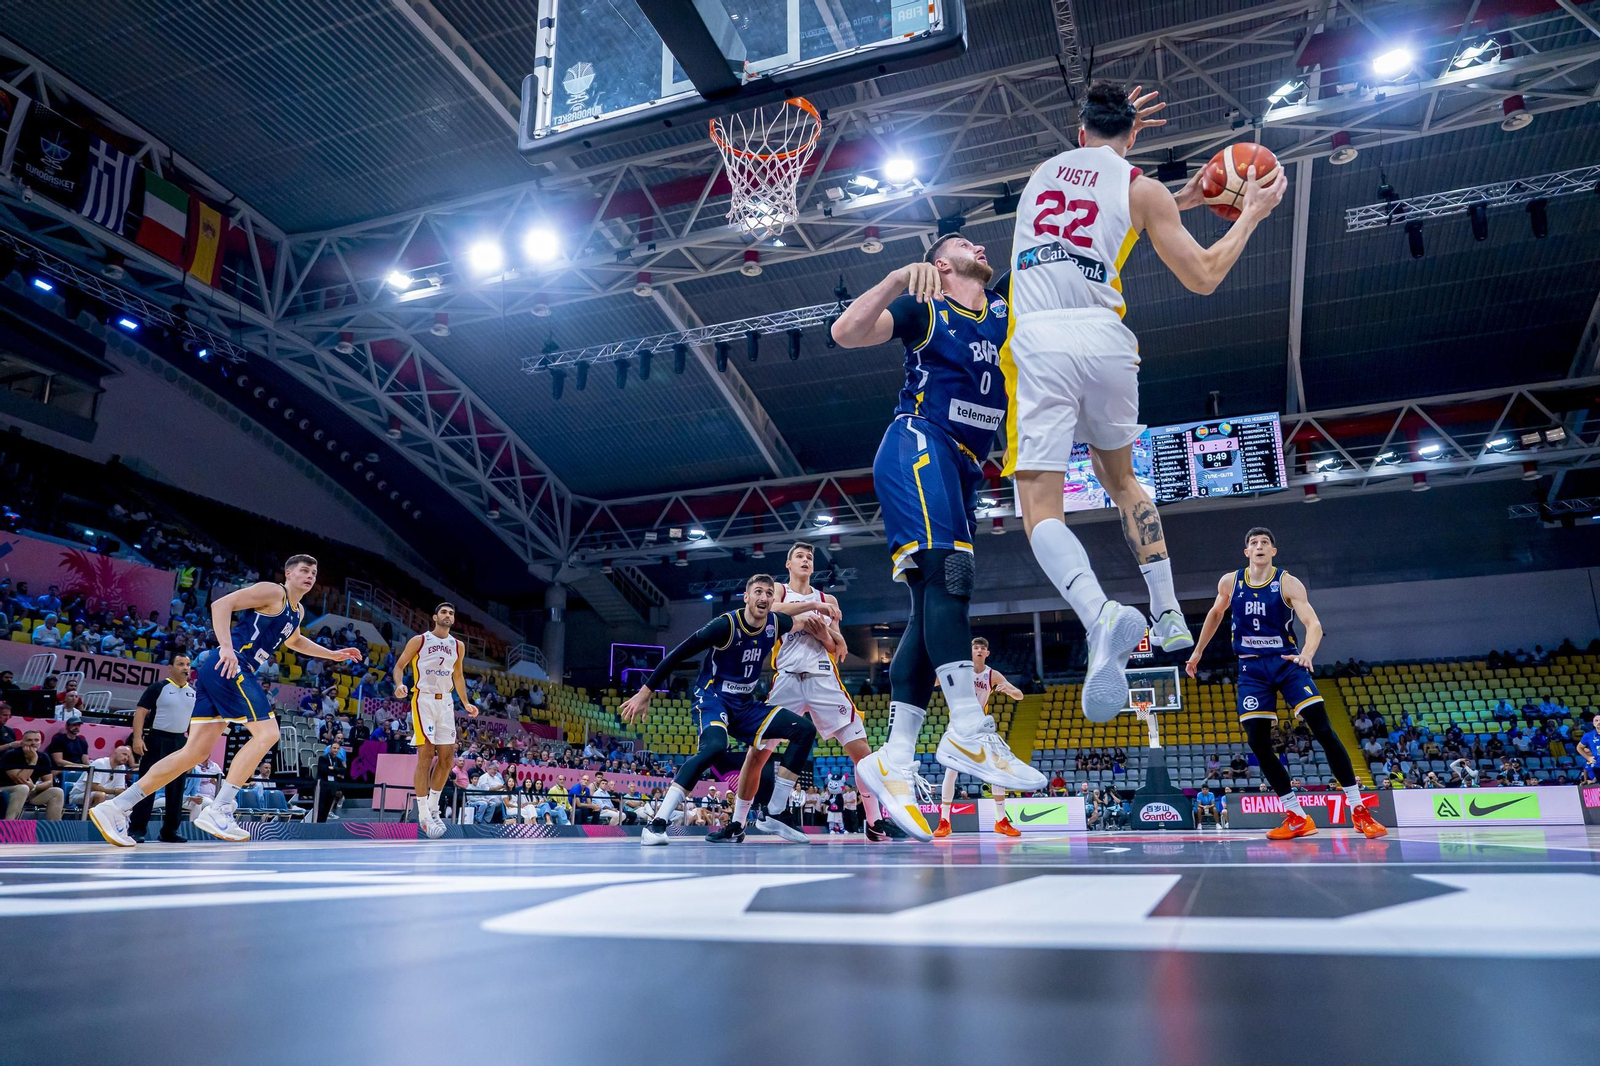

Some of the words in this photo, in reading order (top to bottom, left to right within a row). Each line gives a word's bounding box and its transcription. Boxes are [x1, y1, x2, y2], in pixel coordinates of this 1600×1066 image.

[25, 162, 76, 190] EUROBASKET
[1055, 165, 1100, 187] YUSTA
[1033, 190, 1099, 248] 22
[980, 371, 991, 395] 0
[956, 405, 1001, 425] telemach
[1226, 440, 1232, 448] 2
[1206, 452, 1227, 462] 8:49
[1244, 601, 1266, 616] BIH
[1252, 618, 1260, 631] 9
[428, 645, 452, 657] ESPAÑA
[742, 648, 762, 663] BIH
[439, 656, 445, 666] 7
[744, 664, 754, 678] 17
[919, 804, 939, 813] FREAK
[1298, 795, 1327, 807] FREAK
[1328, 795, 1342, 823] 7
